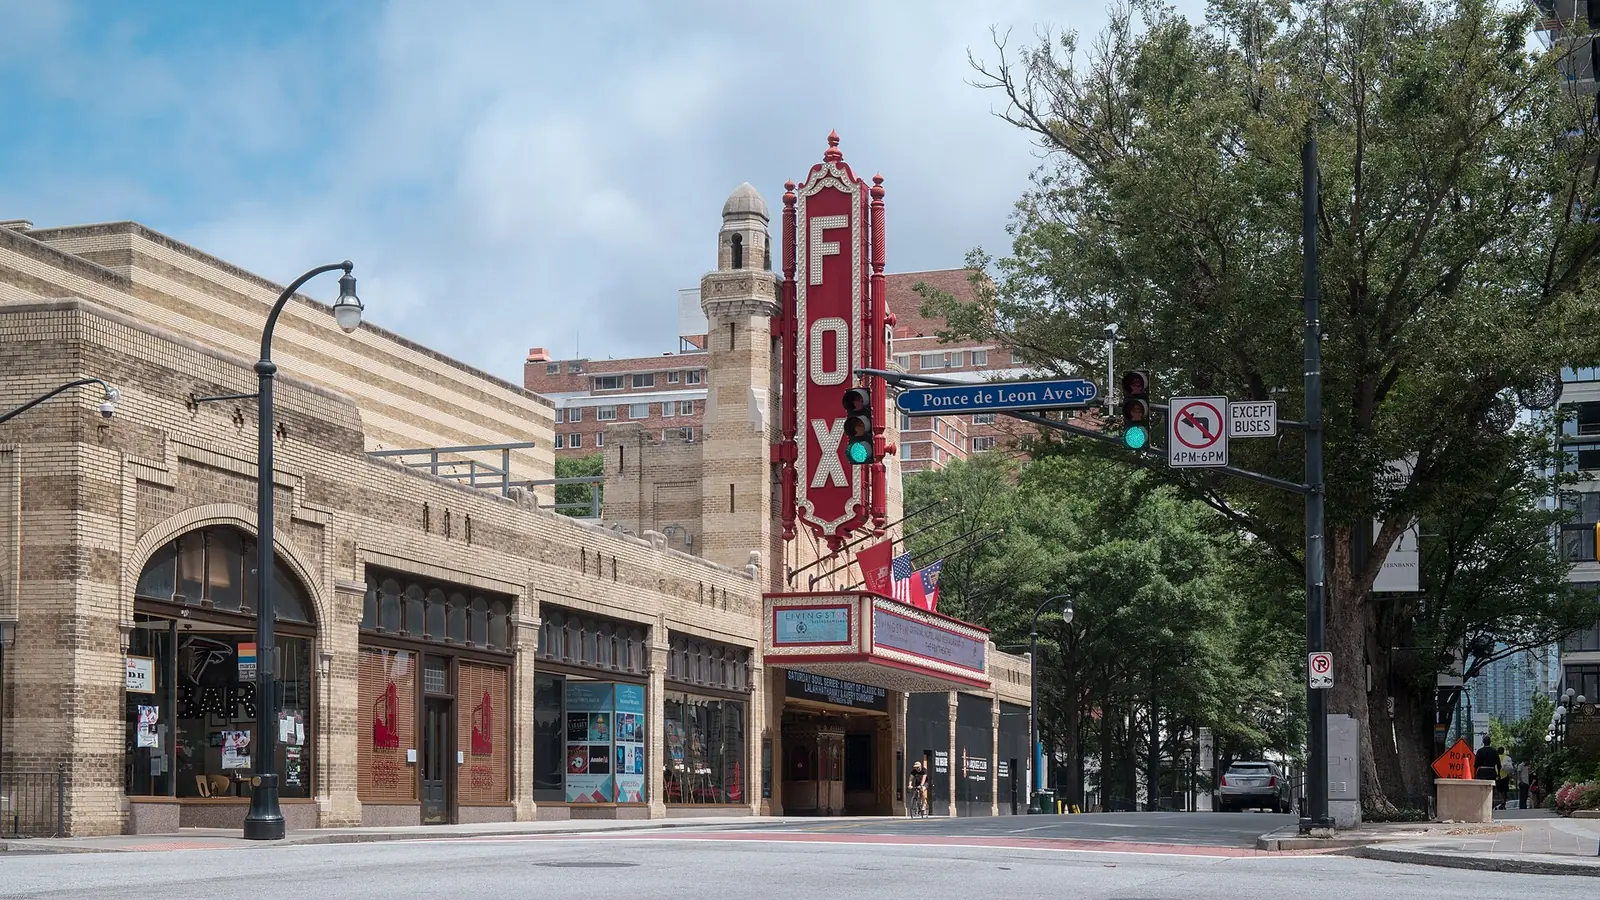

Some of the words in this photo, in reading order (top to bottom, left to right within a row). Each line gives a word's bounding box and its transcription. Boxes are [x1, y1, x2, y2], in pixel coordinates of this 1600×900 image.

[810, 214, 849, 488] FOX
[922, 393, 968, 407] Ponce
[974, 391, 993, 403] de
[998, 389, 1036, 403] Leon
[1043, 387, 1073, 401] Ave
[1076, 386, 1093, 397] NE
[1232, 405, 1273, 418] EXCEPT
[1235, 420, 1270, 432] BUSES
[1173, 451, 1224, 462] 4PM-6PM
[785, 611, 848, 620] LIVINGSTON
[788, 671, 811, 683] SATURDAY
[812, 675, 823, 685] SOUL
[823, 678, 840, 688] SERIES:
[856, 684, 862, 694] OF
[862, 685, 877, 695] CLASSIC
[176, 682, 257, 718] BAR
[1450, 752, 1472, 761] ROAD
